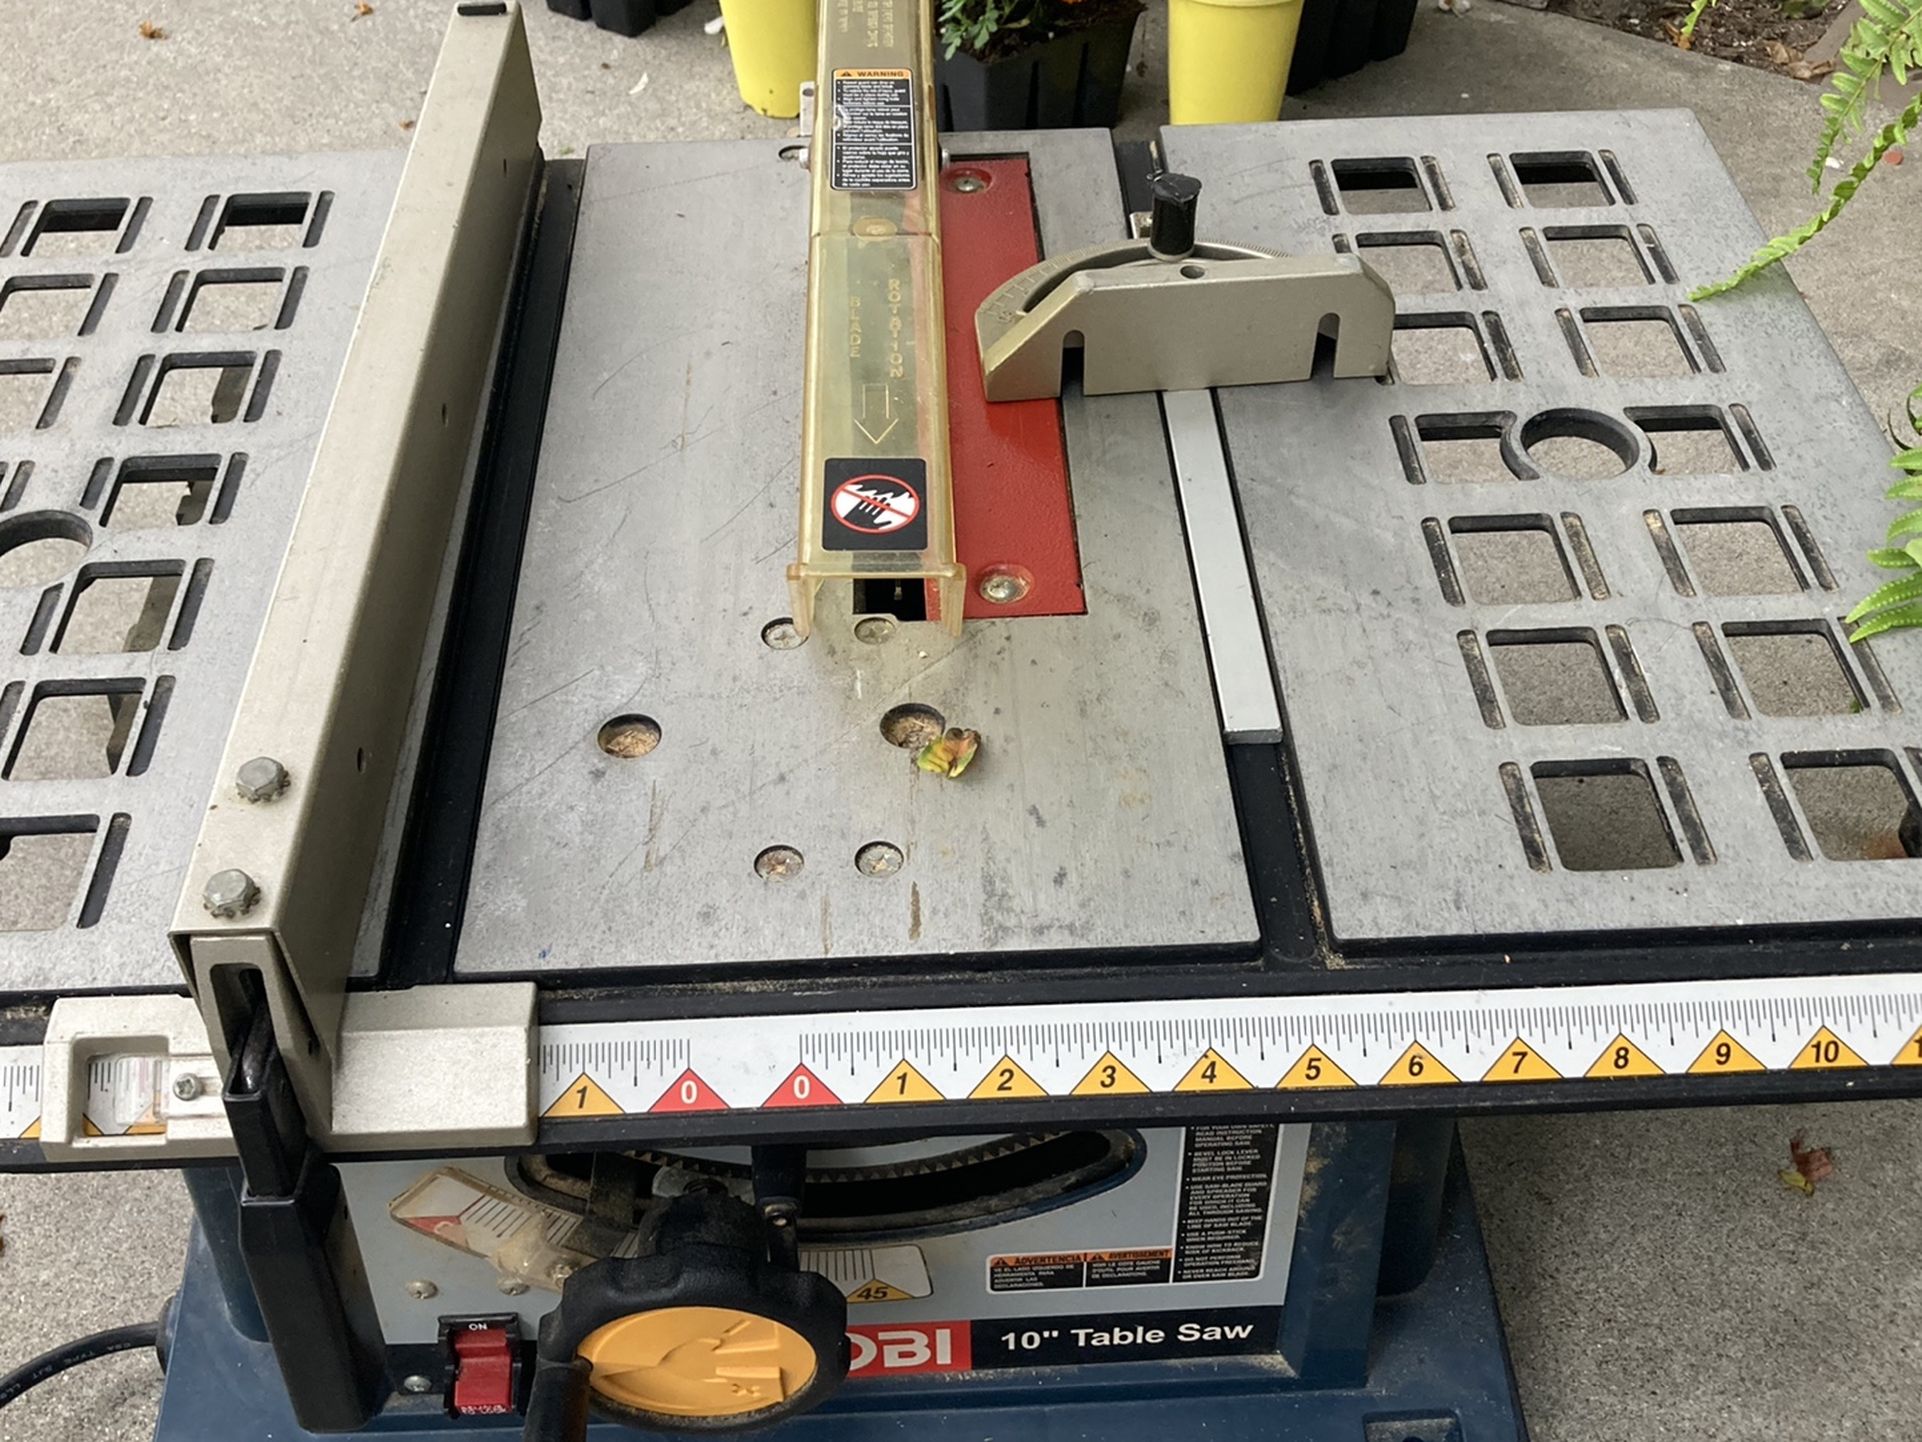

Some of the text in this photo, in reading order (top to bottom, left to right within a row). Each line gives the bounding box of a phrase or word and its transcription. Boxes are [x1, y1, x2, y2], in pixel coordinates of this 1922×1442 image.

[849, 296, 862, 358] BLADE
[887, 278, 904, 378] ROTATION
[576, 1086, 590, 1108] 1
[680, 1080, 697, 1104] 0
[794, 1076, 810, 1099] 0
[896, 1072, 908, 1095] 1
[996, 1068, 1014, 1092] 2
[1100, 1065, 1117, 1088] 3
[1201, 1061, 1218, 1083] 4
[1305, 1057, 1323, 1080] 5
[1408, 1054, 1426, 1077] 6
[1512, 1051, 1528, 1073] 7
[1613, 1047, 1630, 1068] 8
[1715, 1043, 1731, 1065] 9
[1810, 1040, 1839, 1063] 10
[1014, 1255, 1081, 1265] ADVERTENCIA
[1108, 1251, 1169, 1260] AVERTISSEMENT
[858, 1286, 889, 1300] 45
[468, 1323, 488, 1331] ON
[1000, 1322, 1254, 1350] 10" Table Saw
[845, 1328, 952, 1371] OBI
